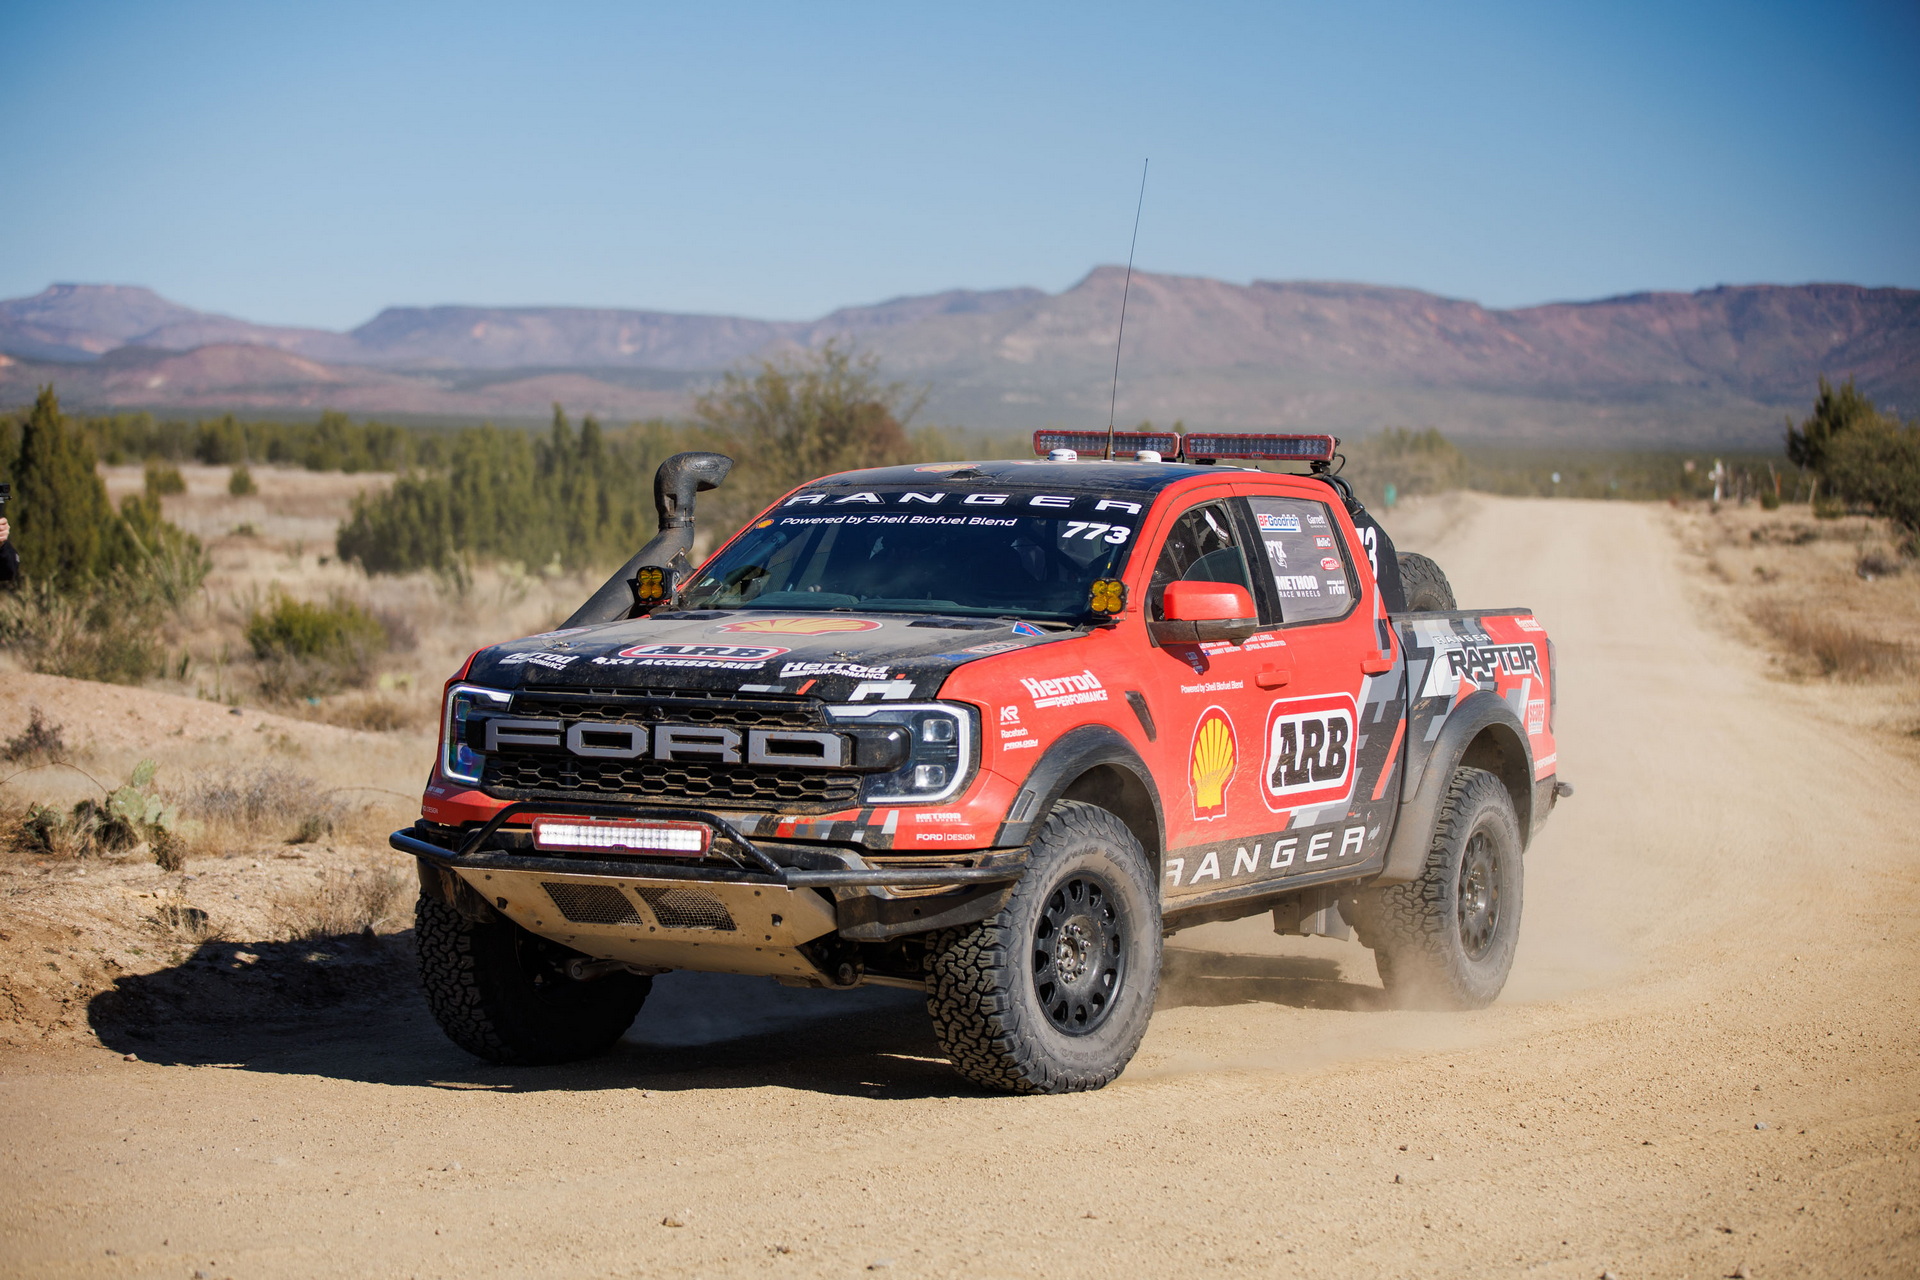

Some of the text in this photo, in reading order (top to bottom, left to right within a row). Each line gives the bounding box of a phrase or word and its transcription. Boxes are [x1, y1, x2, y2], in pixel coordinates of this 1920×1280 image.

[784, 492, 1143, 515] RANGER
[780, 515, 1018, 527] Powered by Shell Biofuel Blend
[1258, 514, 1299, 527] BFGoodrich
[1307, 514, 1325, 525] Garrett
[1062, 521, 1132, 544] 773
[1265, 540, 1287, 560] FOX
[1275, 575, 1319, 591] METHOD
[1297, 590, 1321, 598] WHEELS
[1433, 634, 1492, 645] RANGER
[505, 652, 580, 665] Herrod
[637, 645, 766, 659] ARB
[637, 658, 767, 670] ACCESSORIES
[781, 661, 892, 674] Herrod
[1444, 643, 1544, 690] RAPTOR
[806, 669, 888, 680] PERFORMANCE
[1019, 670, 1103, 699] Herrod
[1180, 685, 1199, 694] Powered
[1205, 682, 1217, 692] Shell
[1216, 681, 1231, 691] Biofuel
[1231, 680, 1243, 689] Blend
[1055, 690, 1109, 707] PERFORMANCE
[1000, 705, 1020, 721] KR
[1001, 727, 1028, 739] Racetech
[485, 718, 852, 768] FORD
[1272, 717, 1349, 789] ARB
[916, 833, 976, 841] FORD DESIGN
[1166, 825, 1367, 887] RANGER
